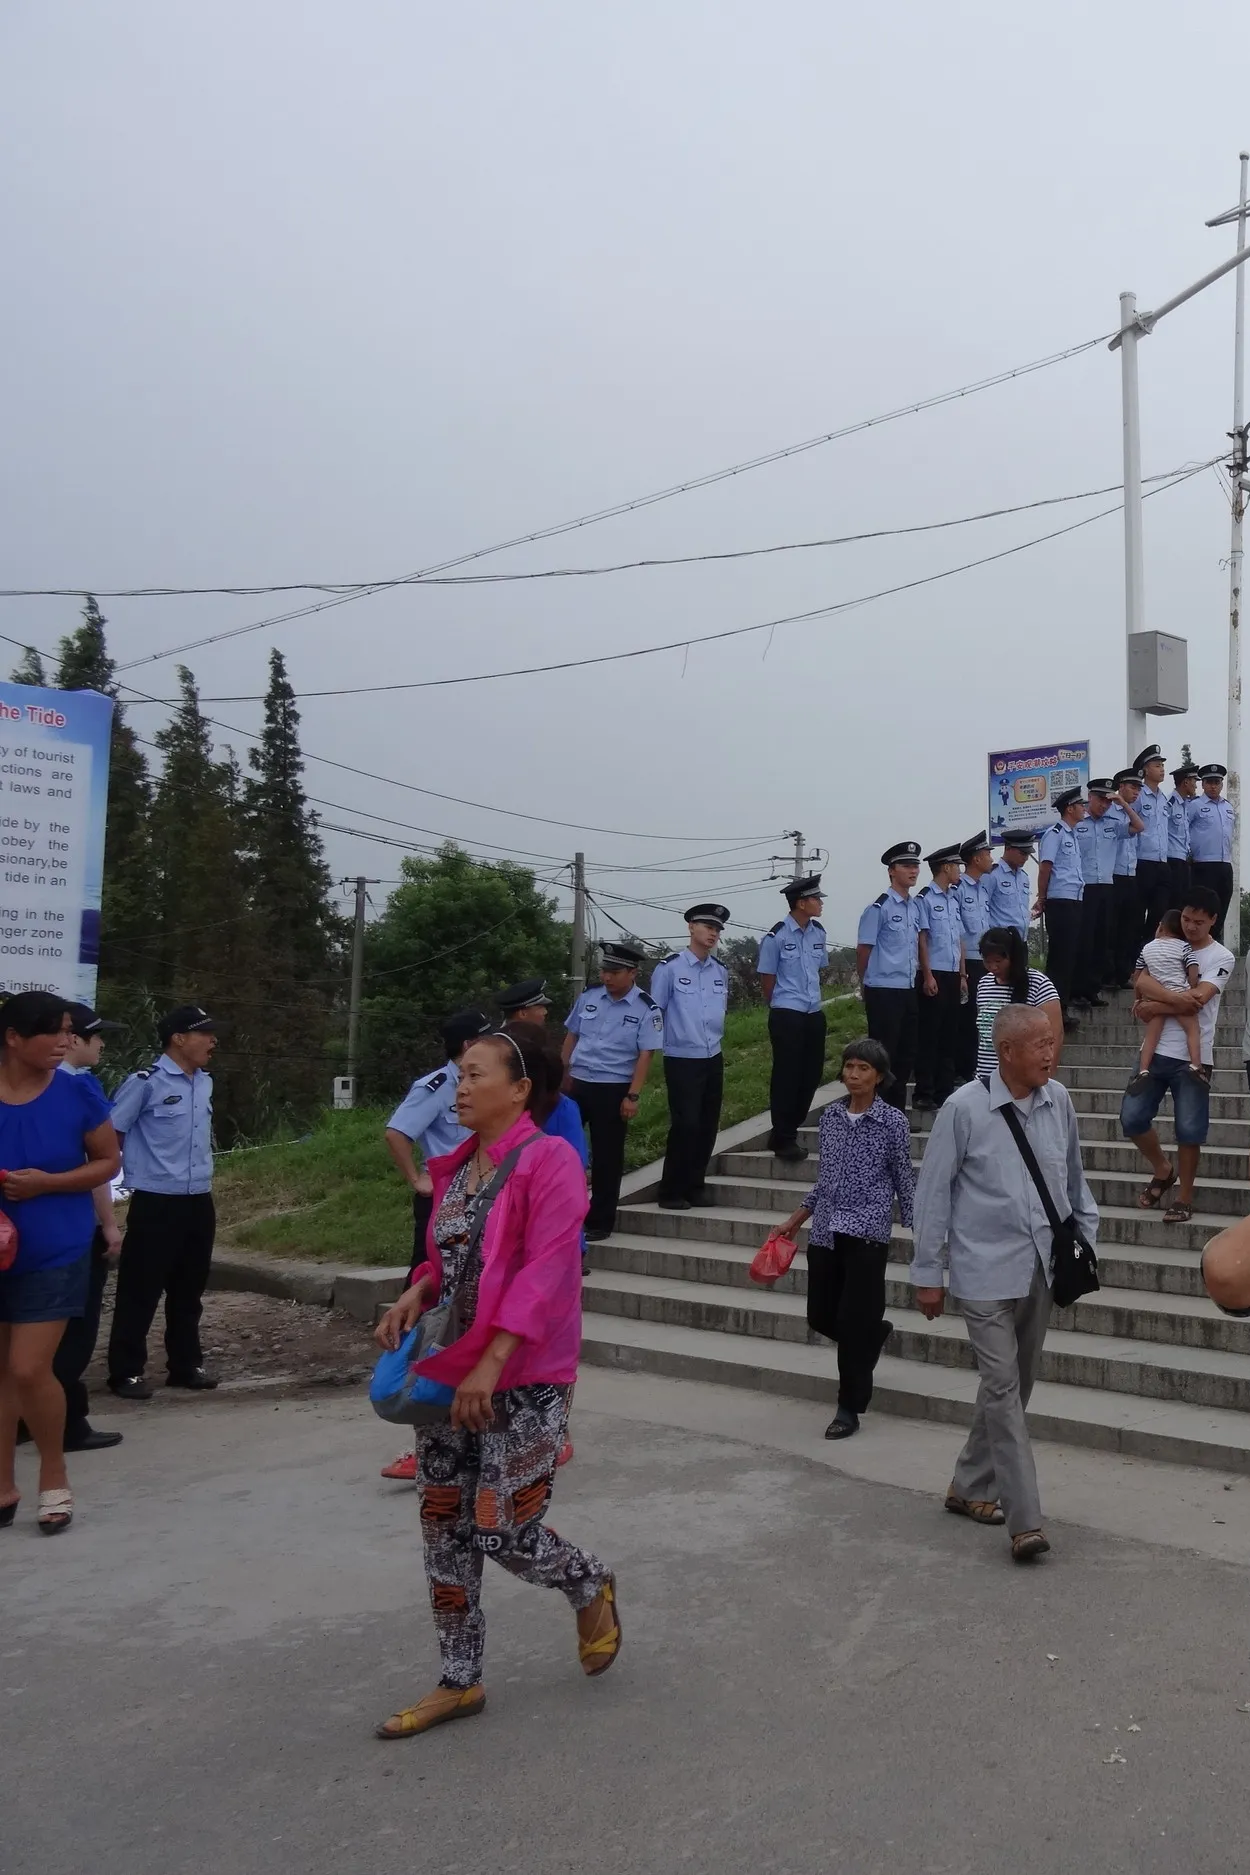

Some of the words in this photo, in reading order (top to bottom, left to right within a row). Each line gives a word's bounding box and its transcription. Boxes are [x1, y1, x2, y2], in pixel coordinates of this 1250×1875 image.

[26, 705, 66, 726] Tide
[14, 747, 28, 757] of
[33, 748, 75, 764] tourist
[51, 770, 73, 781] are
[9, 781, 40, 795] laws
[47, 788, 72, 799] and
[24, 818, 41, 833] by
[49, 822, 70, 834] the
[1, 836, 35, 850] obey
[48, 839, 69, 851] the
[5, 871, 29, 884] tide
[34, 873, 46, 884] in
[50, 877, 67, 886] an
[25, 908, 37, 919] in
[44, 910, 65, 921] the
[31, 929, 63, 939] zone
[38, 945, 62, 957] into
